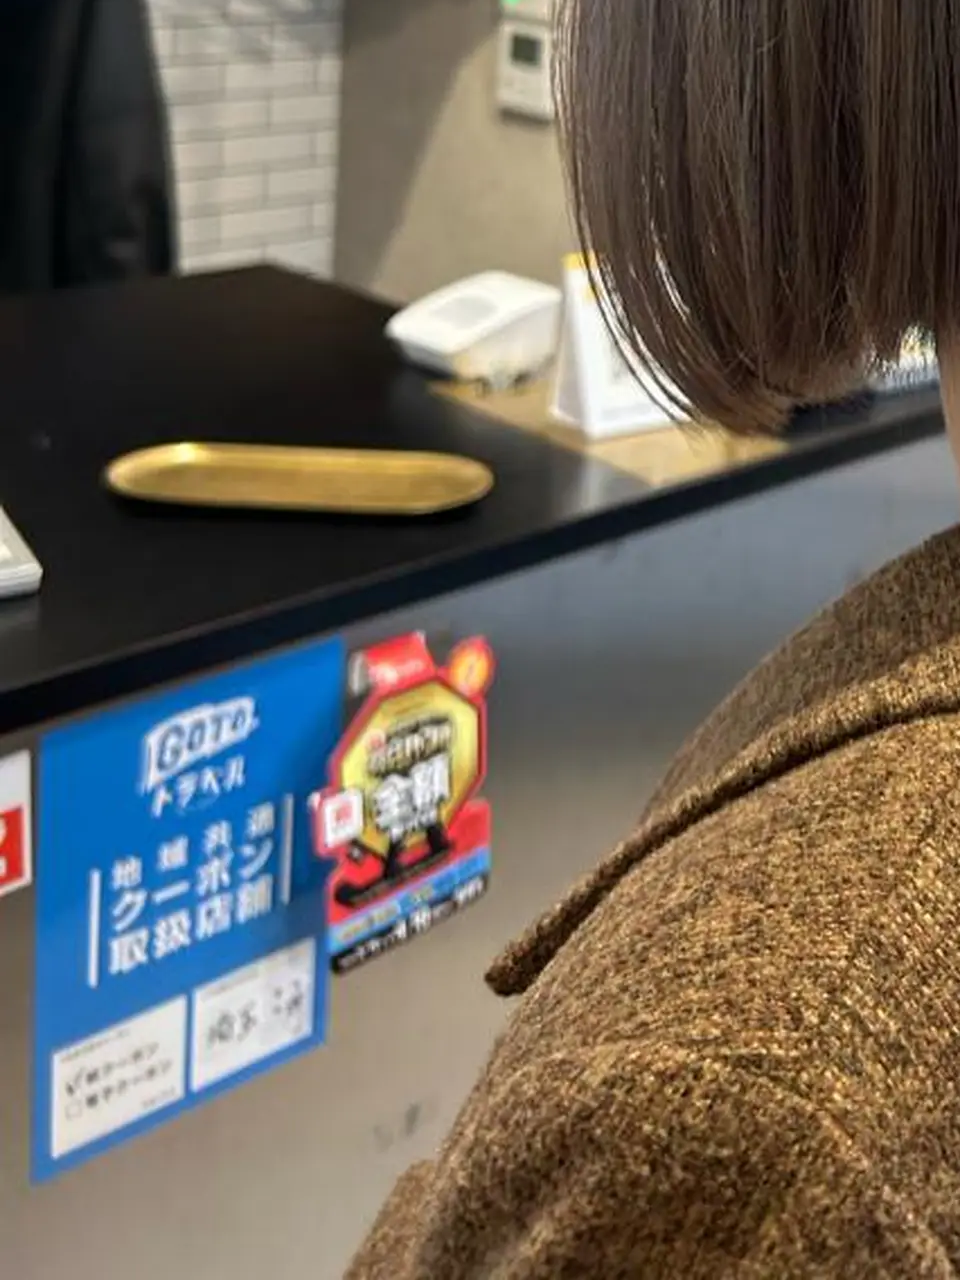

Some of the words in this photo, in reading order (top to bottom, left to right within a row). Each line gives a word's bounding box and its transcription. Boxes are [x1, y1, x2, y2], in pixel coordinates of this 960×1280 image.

[151, 754, 245, 818] トラベル
[109, 873, 273, 974] 取扱店舗
[112, 836, 274, 932] クーポン
